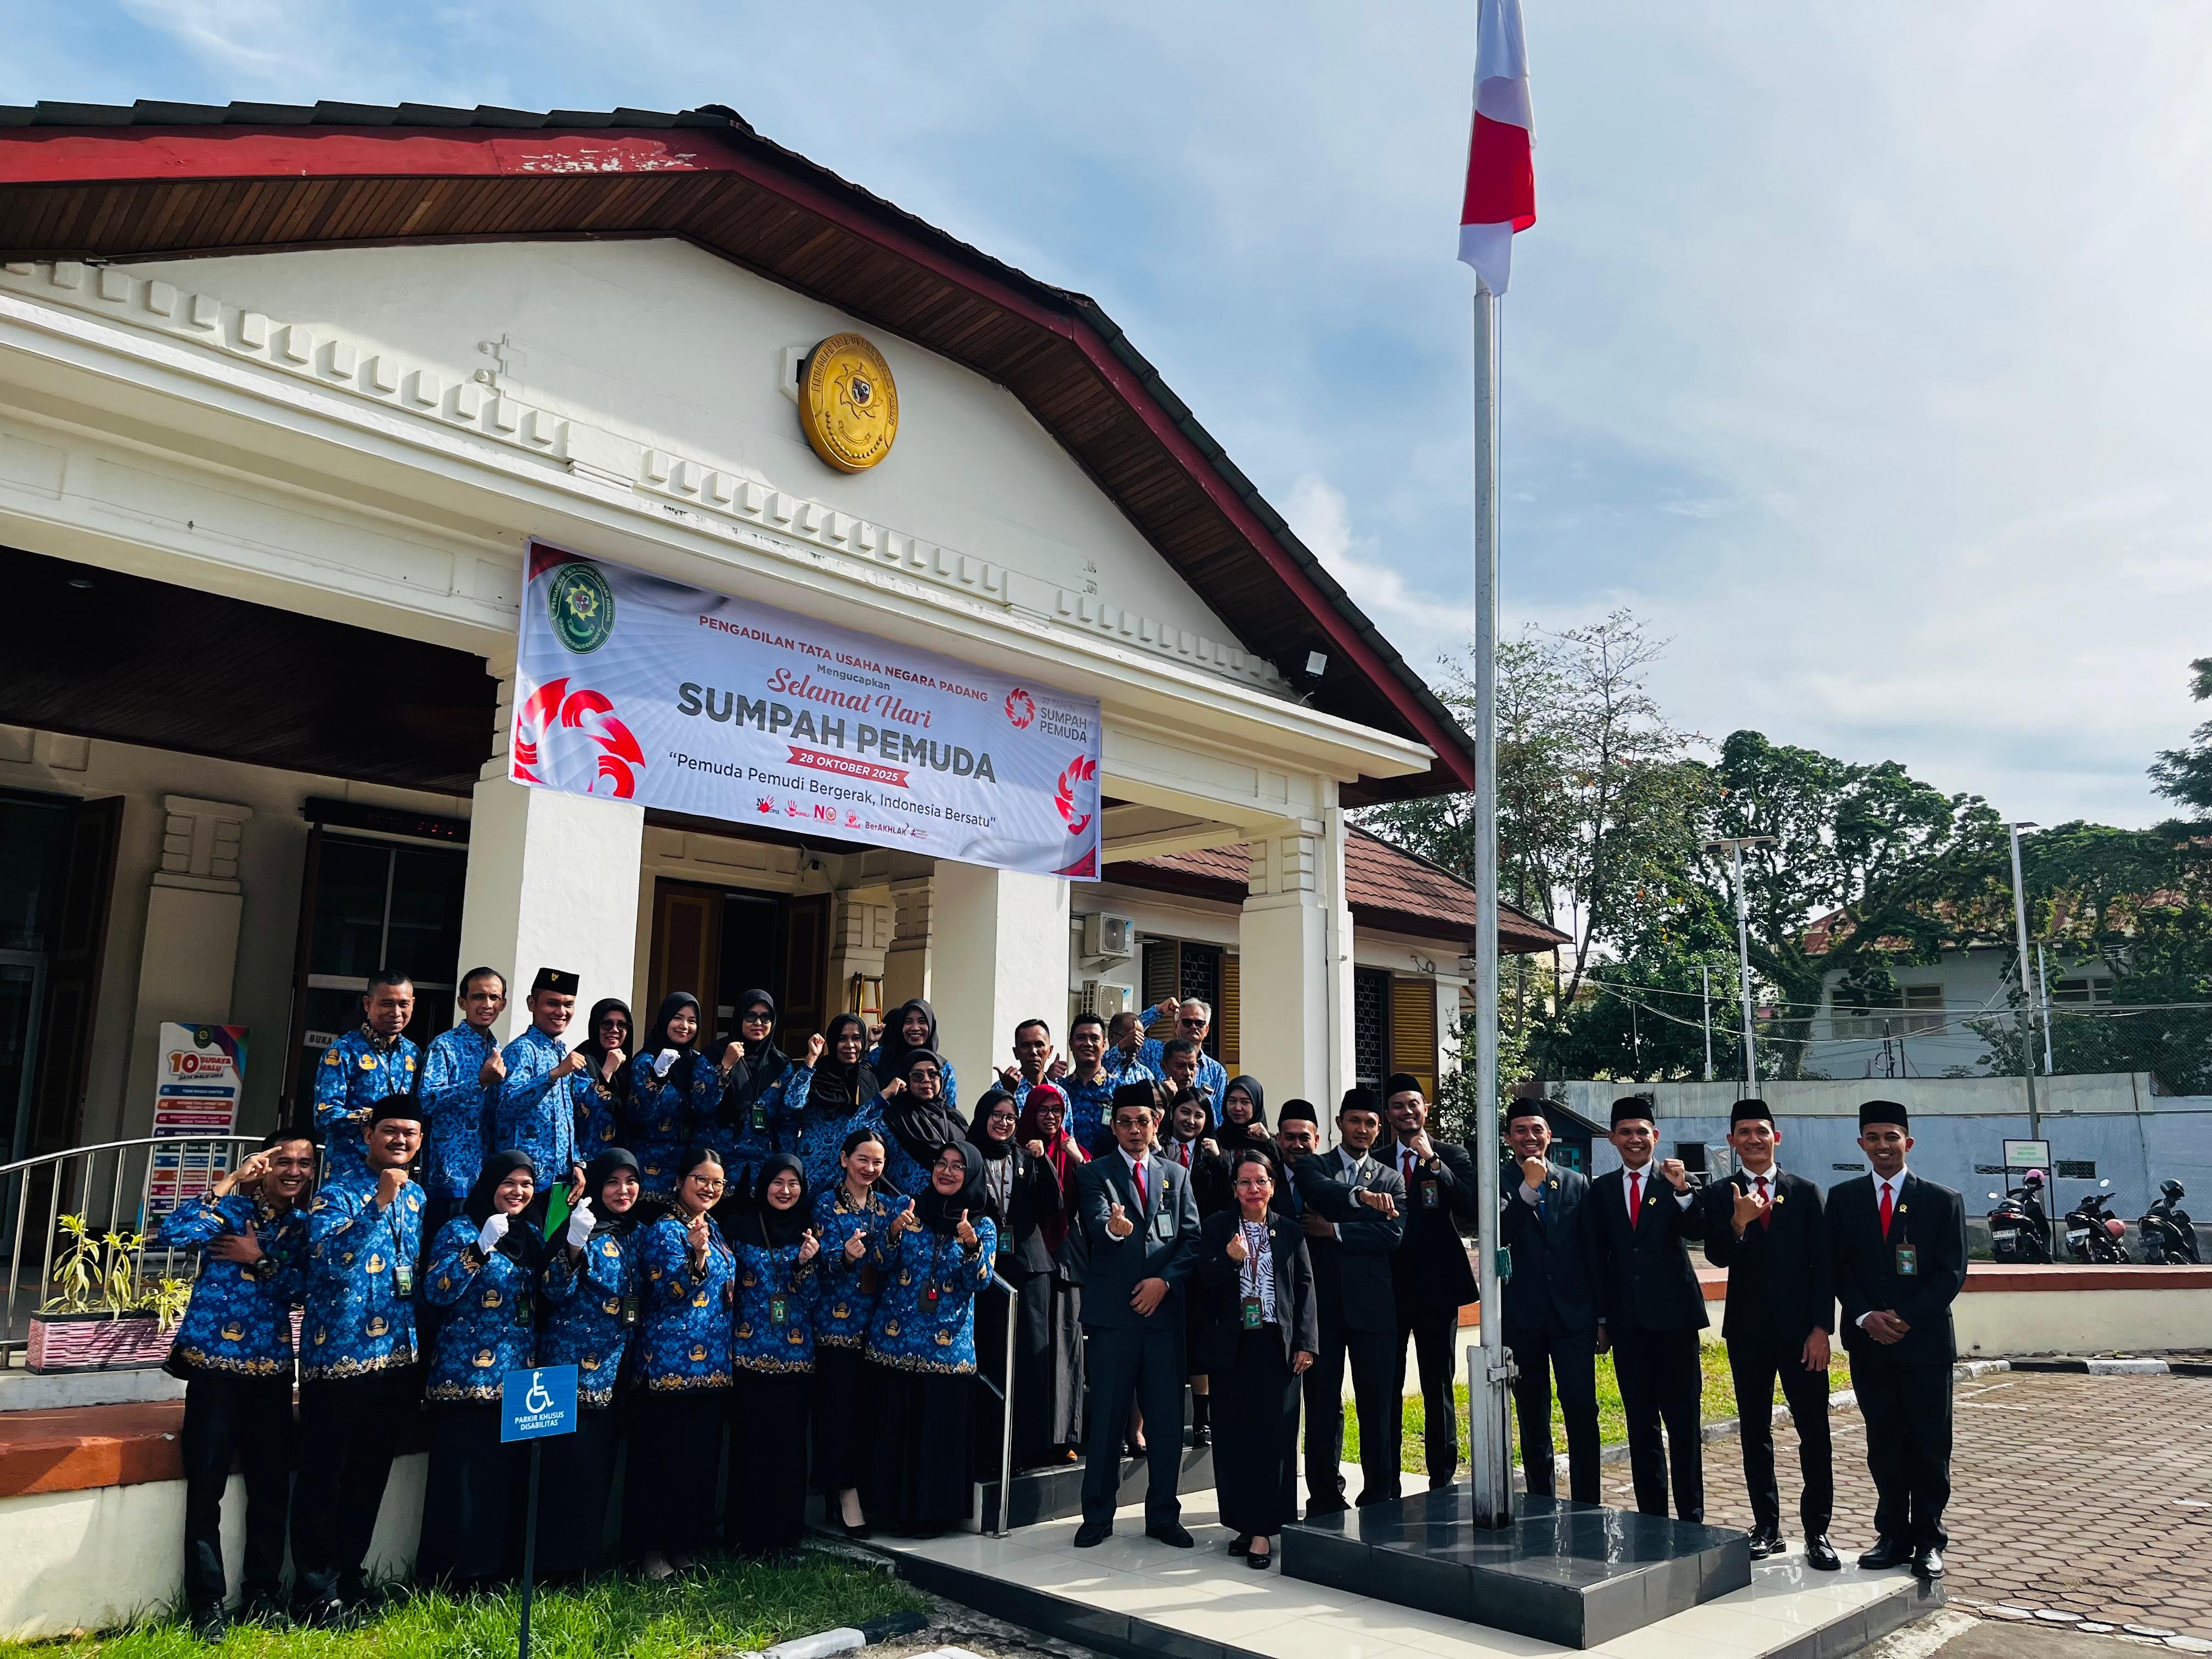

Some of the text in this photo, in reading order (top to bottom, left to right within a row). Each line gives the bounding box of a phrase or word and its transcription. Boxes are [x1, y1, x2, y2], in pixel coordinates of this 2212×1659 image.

[551, 575, 566, 609] PENGADILAN
[565, 567, 576, 575] TATA
[699, 615, 988, 702] PENGADILAN TATA USAHA NEGARA PADANG
[817, 663, 890, 690] Mengucapkan
[767, 668, 932, 728] Selamat Hari
[1040, 720, 1087, 743] PEMUDA
[1041, 707, 1087, 730] SUMPAH
[676, 682, 996, 783] SUMPAH PEMUDA
[799, 753, 899, 782] 28 OKTOBER 2025
[748, 768, 804, 790] Pemudi
[809, 780, 875, 806] Bergerak,
[881, 794, 941, 817] Indonesia
[865, 822, 907, 836] BerAKHLAK
[171, 1053, 199, 1073] 10
[515, 1411, 565, 1424] PARKIR KHUSUS
[521, 1419, 558, 1431] DISABILITAS
